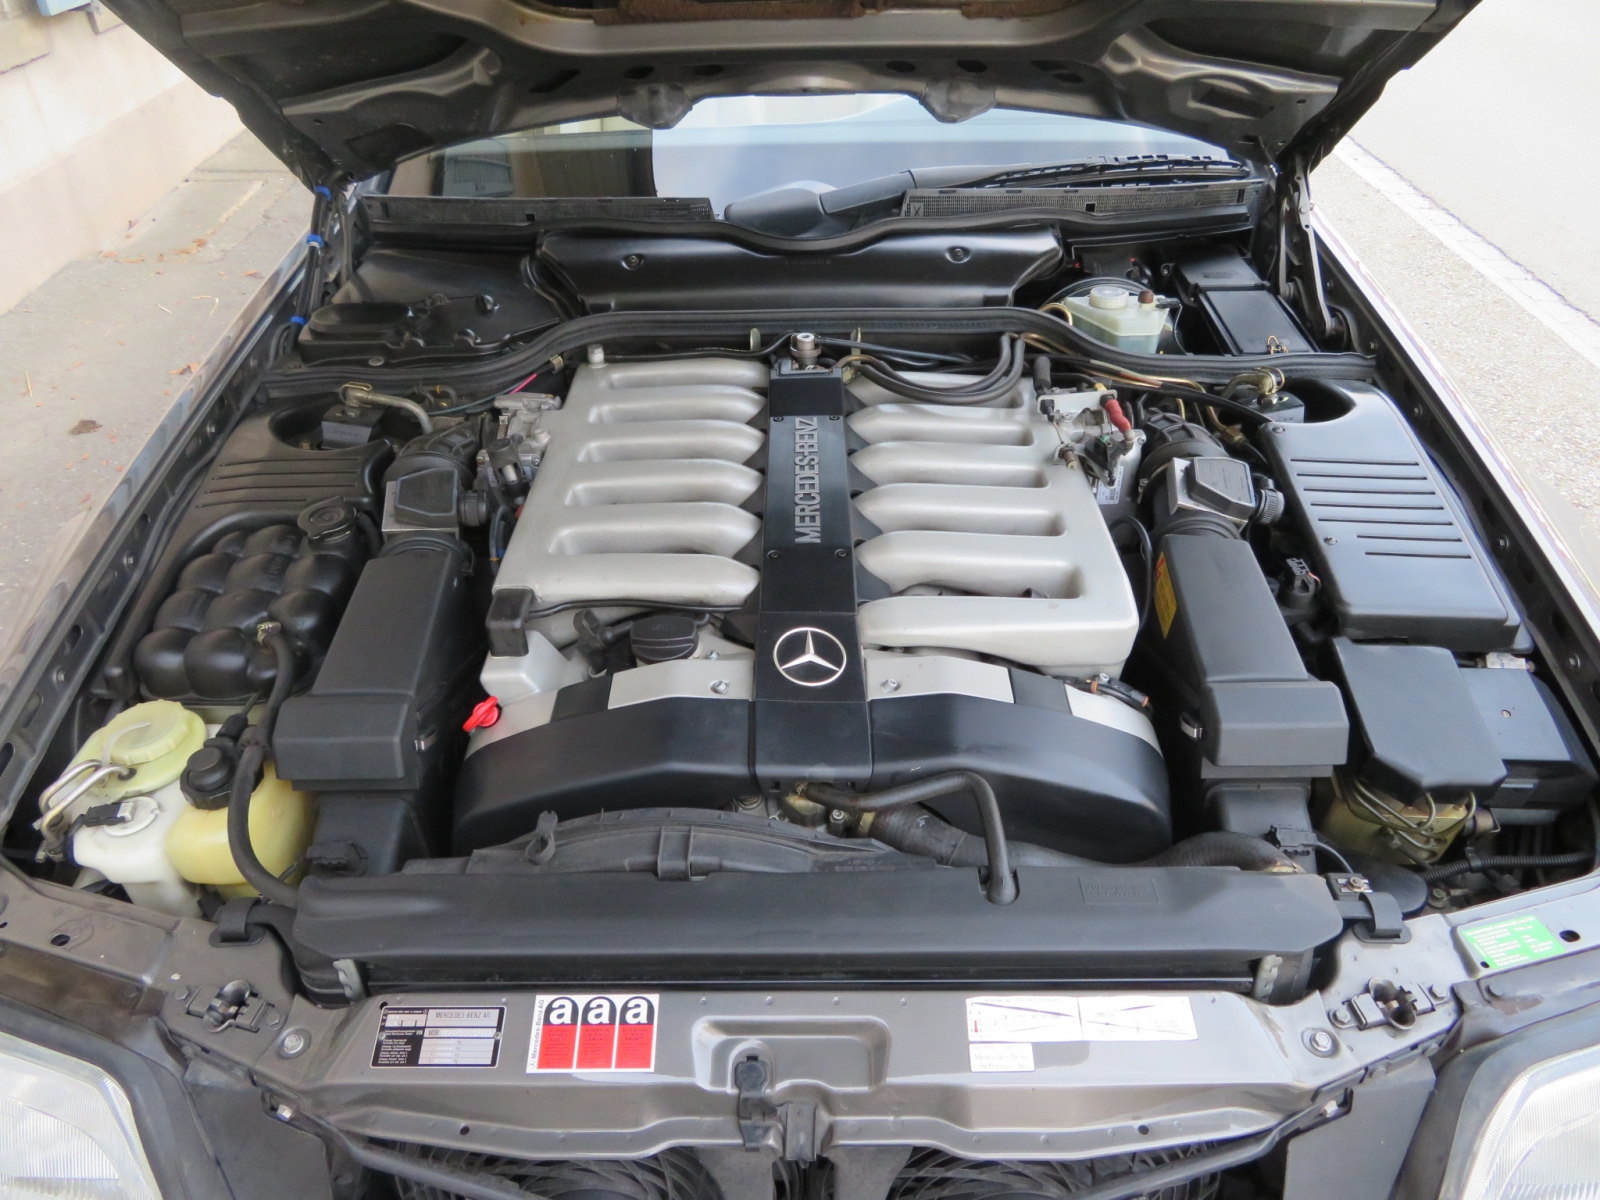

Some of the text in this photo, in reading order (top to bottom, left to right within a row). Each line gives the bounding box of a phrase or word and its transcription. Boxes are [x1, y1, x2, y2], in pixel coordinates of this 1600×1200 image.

[795, 417, 821, 544] MERCEDES-BENZ
[549, 998, 573, 1025] a
[587, 998, 610, 1025] a
[625, 998, 648, 1025] a
[531, 999, 545, 1060] Mercedes-Benz AG
